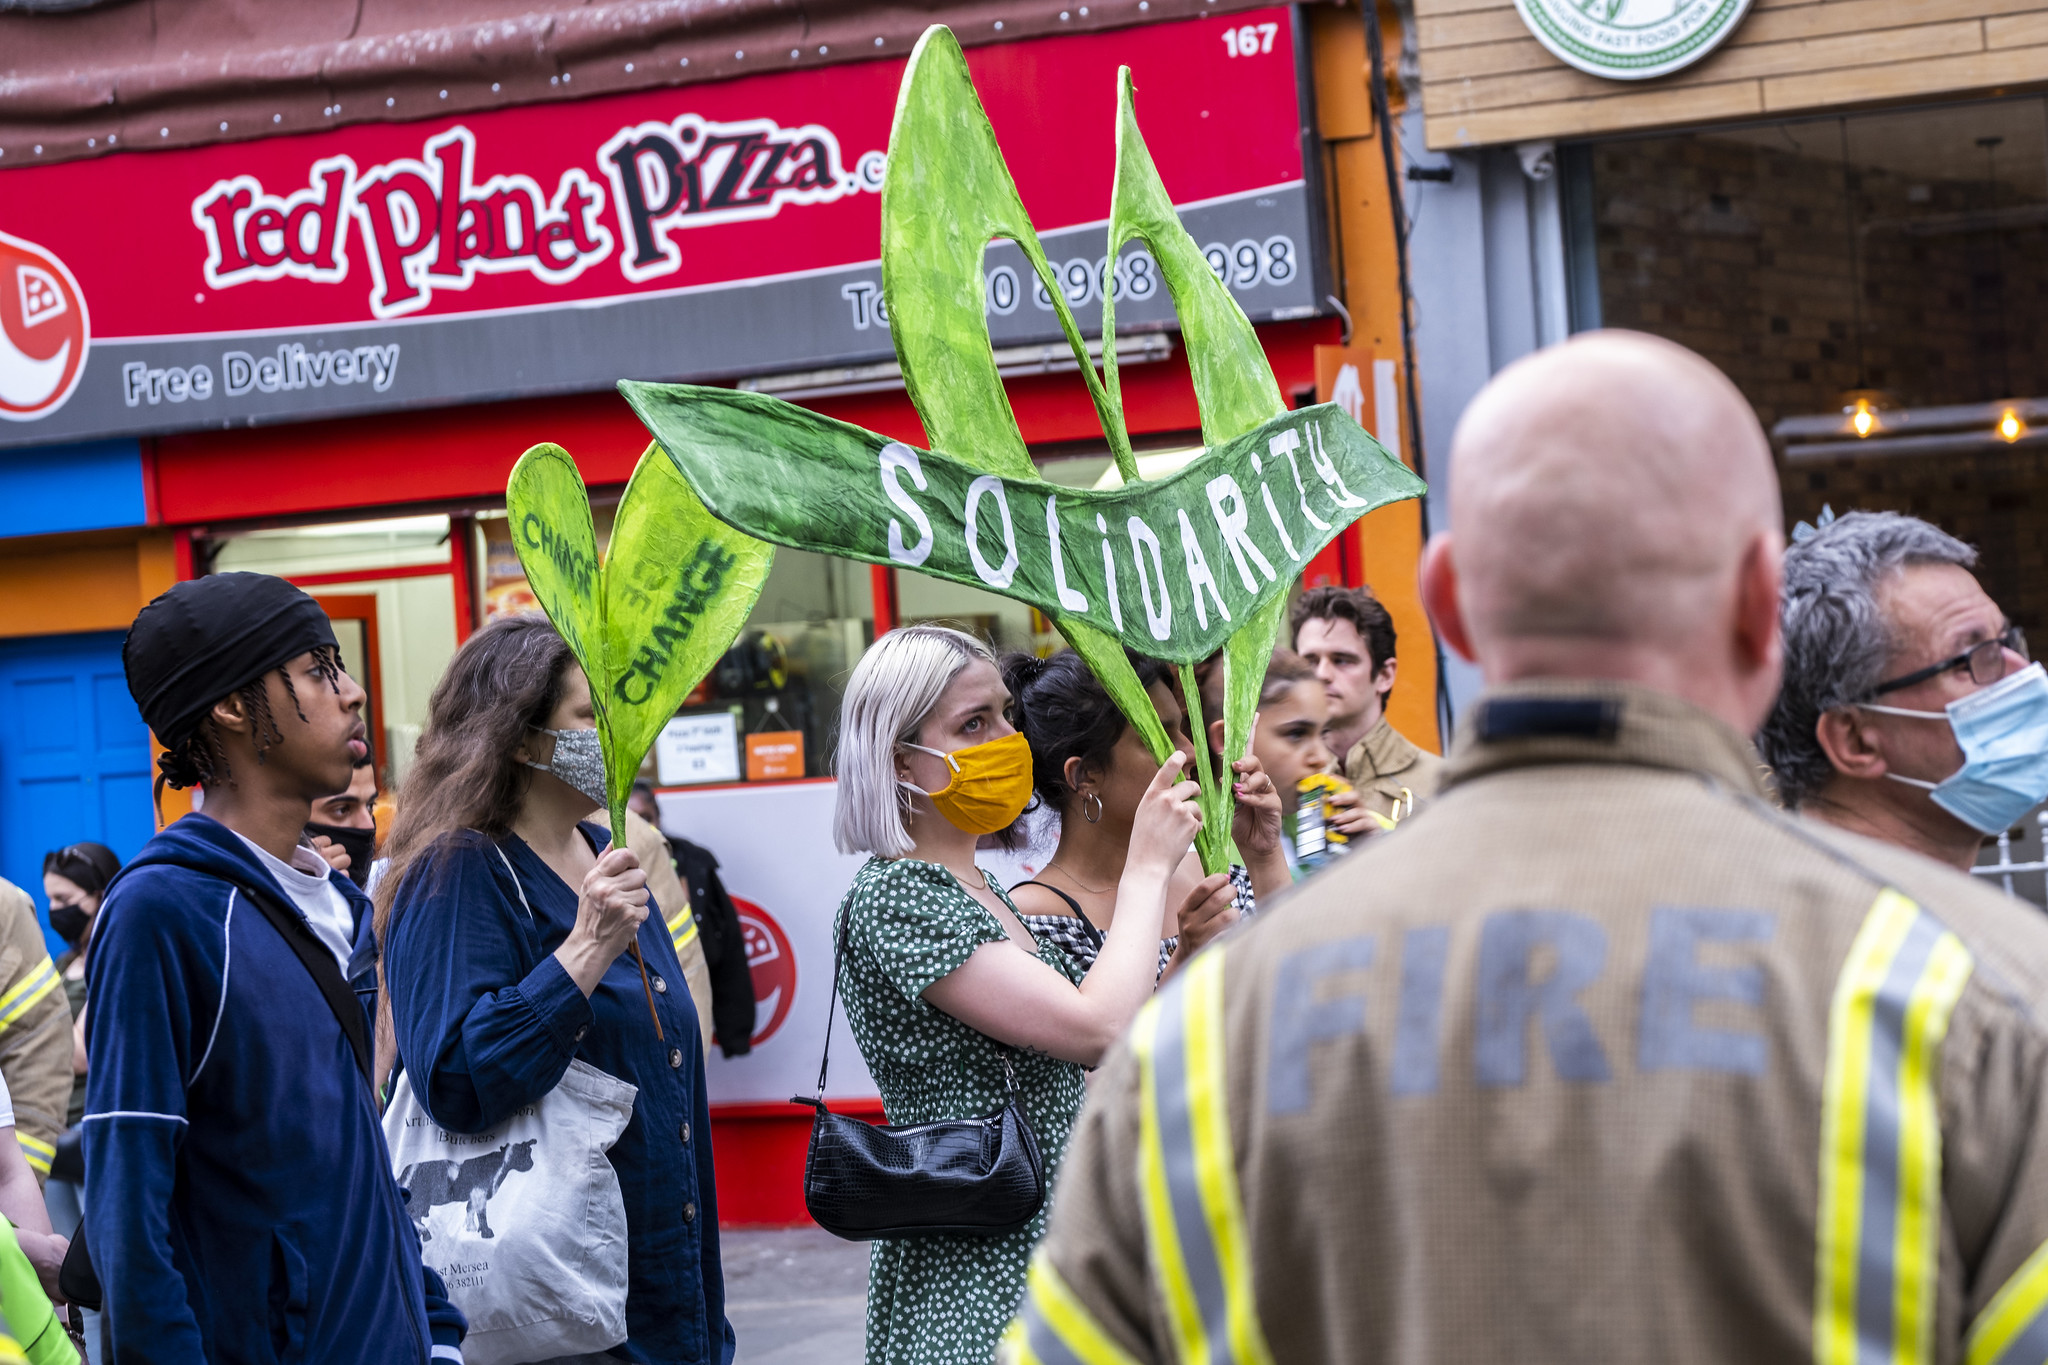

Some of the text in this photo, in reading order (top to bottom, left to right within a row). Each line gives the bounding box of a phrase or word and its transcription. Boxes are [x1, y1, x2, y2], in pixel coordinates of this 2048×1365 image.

[1221, 22, 1279, 58] 167
[1596, 29, 1632, 48] FAST
[1636, 24, 1682, 47] FOOD
[192, 155, 357, 289] red
[841, 281, 890, 330] Te
[122, 343, 400, 407] Free Delivery
[613, 537, 737, 706] CHANGE
[1266, 906, 1778, 1118] FIRE
[450, 1261, 489, 1275] Mersea
[456, 1275, 484, 1288] 382111
